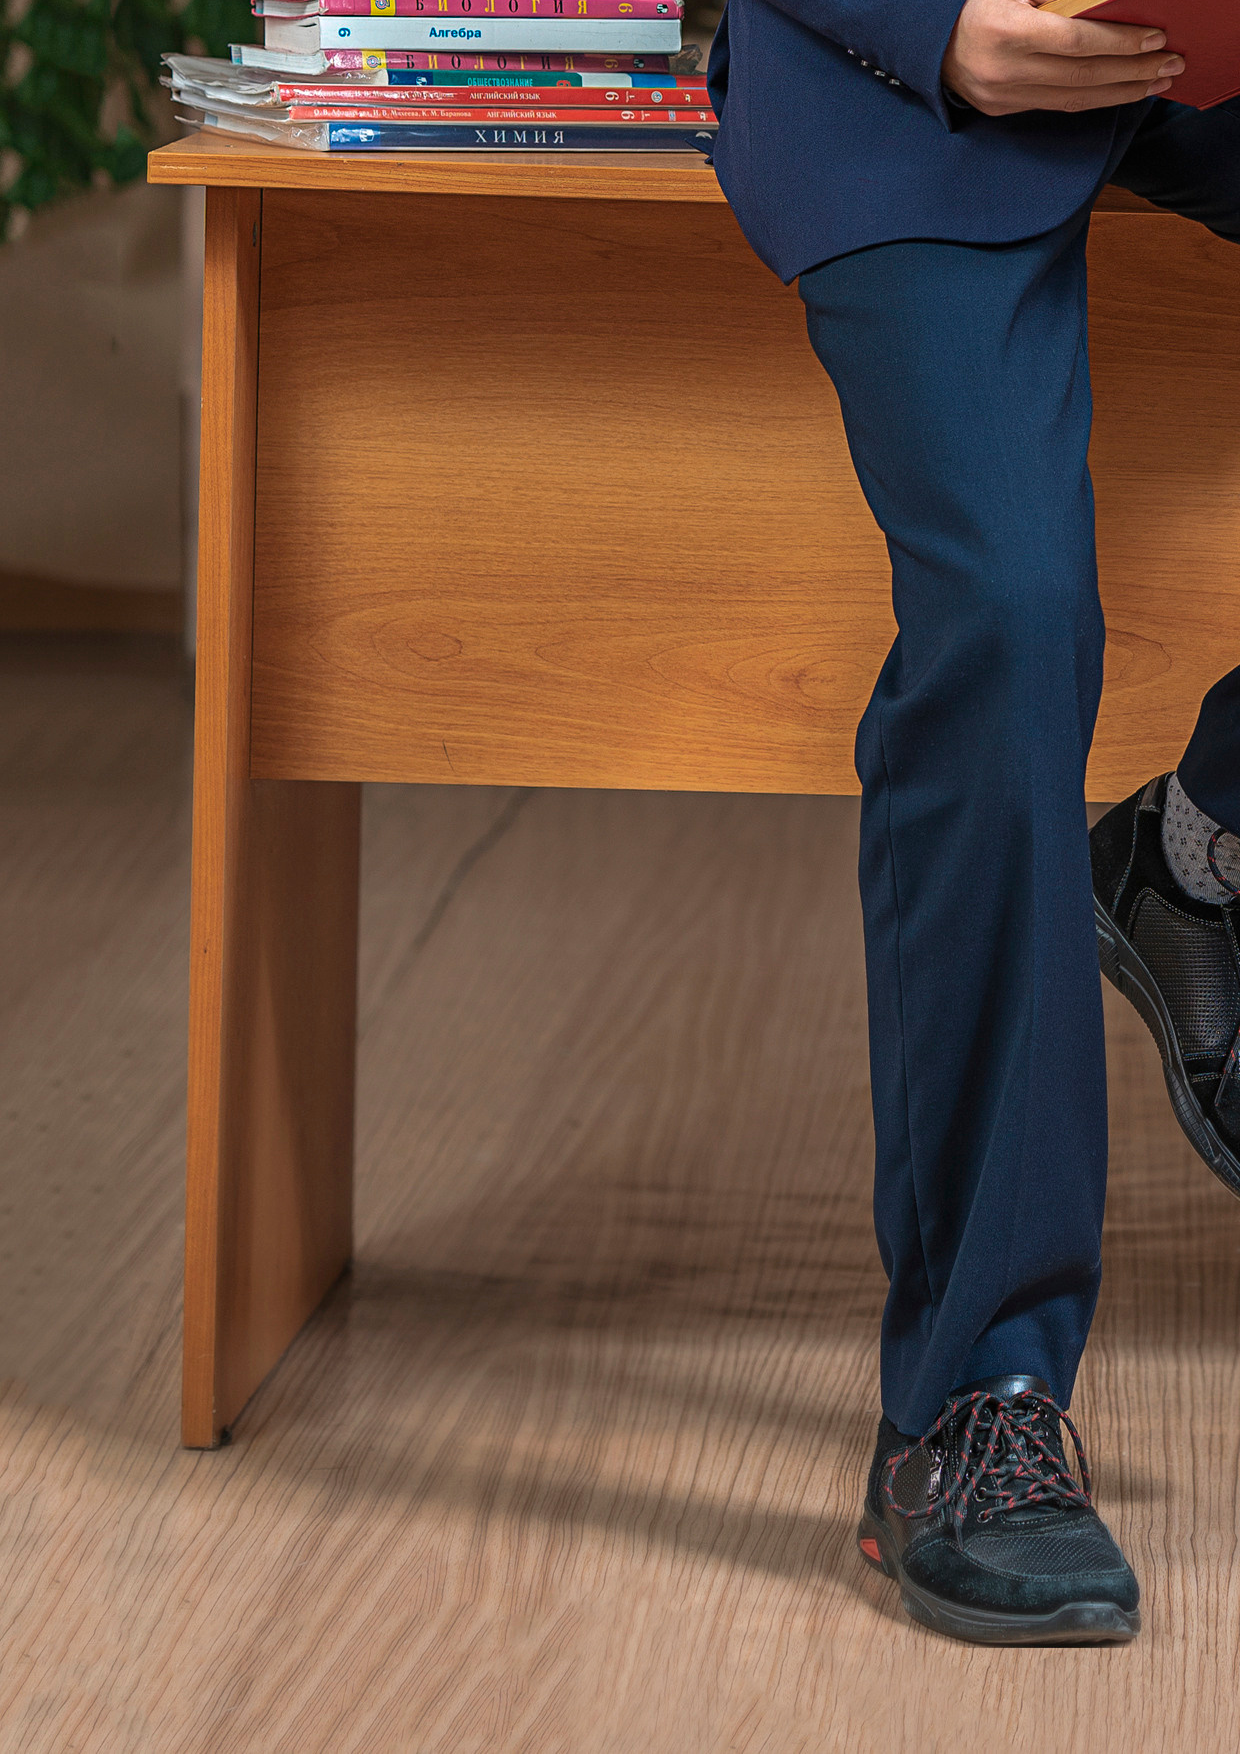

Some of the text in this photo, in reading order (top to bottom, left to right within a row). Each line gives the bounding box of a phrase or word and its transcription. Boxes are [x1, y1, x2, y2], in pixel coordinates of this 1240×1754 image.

[429, 27, 482, 40] Алгебра
[406, 54, 575, 70] БИОЛОГИЯ
[467, 77, 533, 87] ОБЩЕСТВОЗНАНИЕ
[469, 91, 519, 100] АНГЛИЙСКИЙ
[520, 92, 541, 100] ЯЗЫК
[440, 110, 472, 118] Баранова
[486, 110, 535, 118] АНГЛИЙСКИЙ
[536, 111, 557, 119] ЯЗЫК
[474, 129, 565, 144] ХИМИЯ
